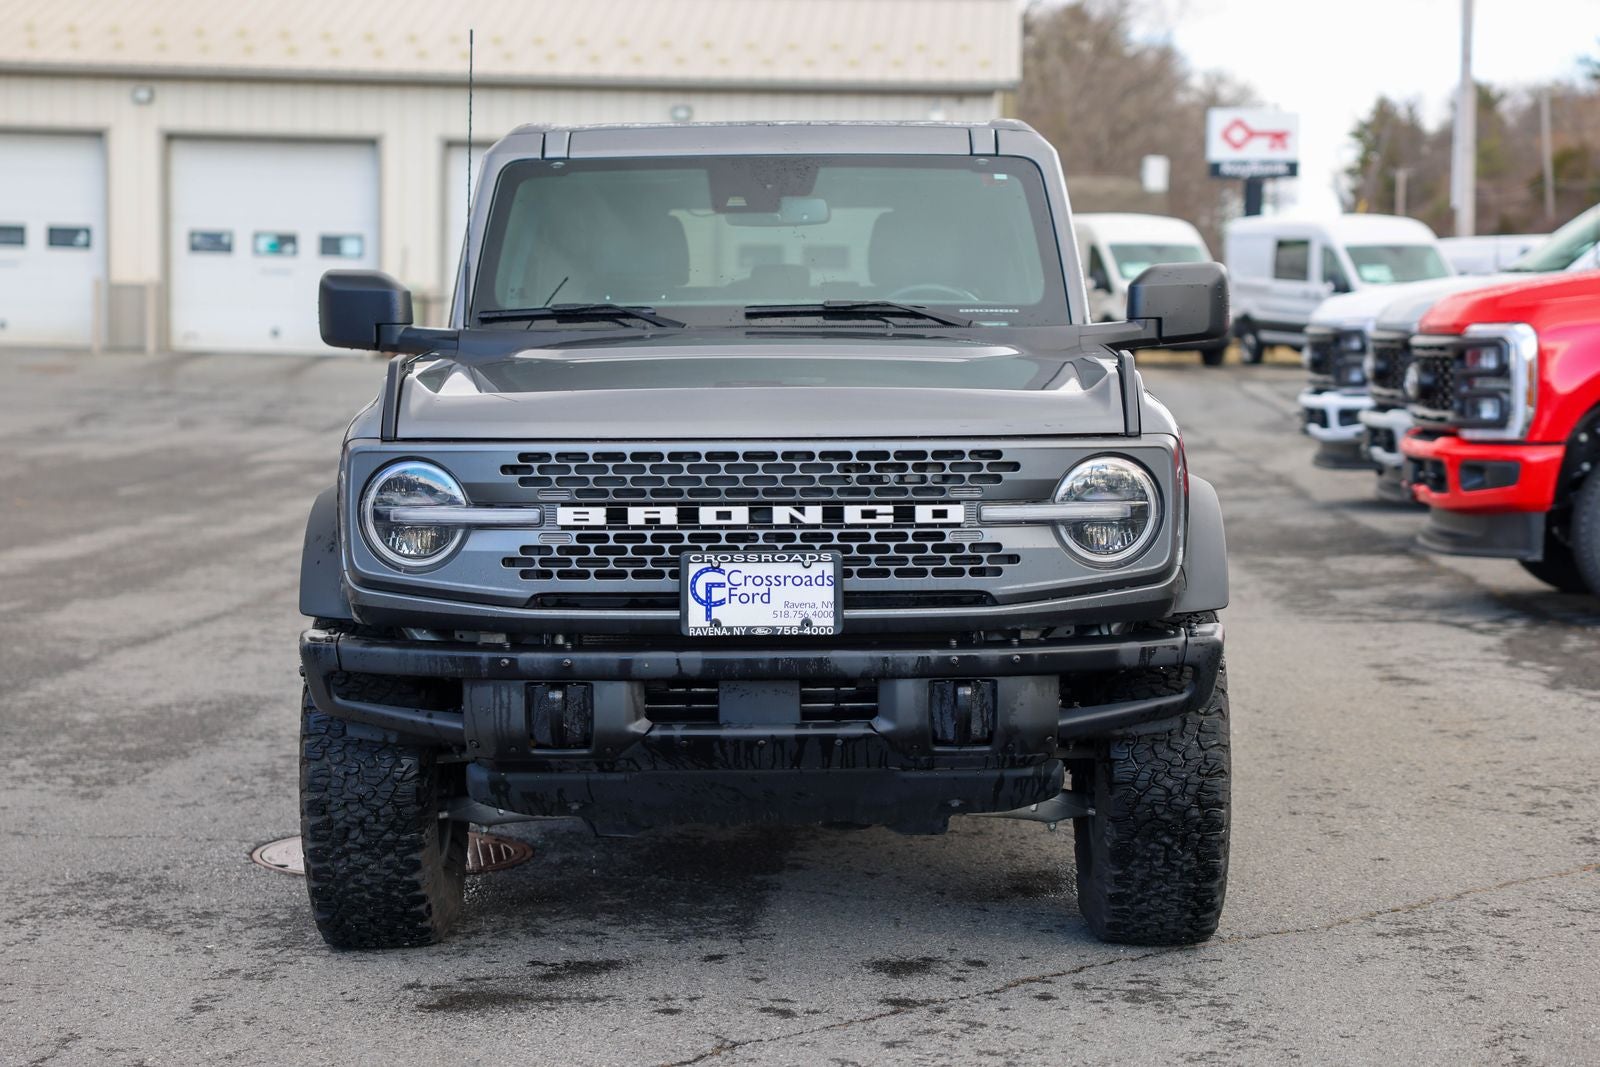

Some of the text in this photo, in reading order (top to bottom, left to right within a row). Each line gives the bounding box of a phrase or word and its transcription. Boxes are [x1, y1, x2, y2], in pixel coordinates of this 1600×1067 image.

[556, 506, 965, 525] BRONCO
[689, 553, 833, 562] CROSSROADS
[727, 570, 834, 587] Crossroads
[728, 587, 771, 604] Ford
[784, 601, 834, 609] Ravena, NY
[772, 611, 834, 619] 518.756.4000
[689, 628, 731, 636] RAVENA,
[733, 627, 746, 636] NY
[776, 627, 834, 635] 756-4000
